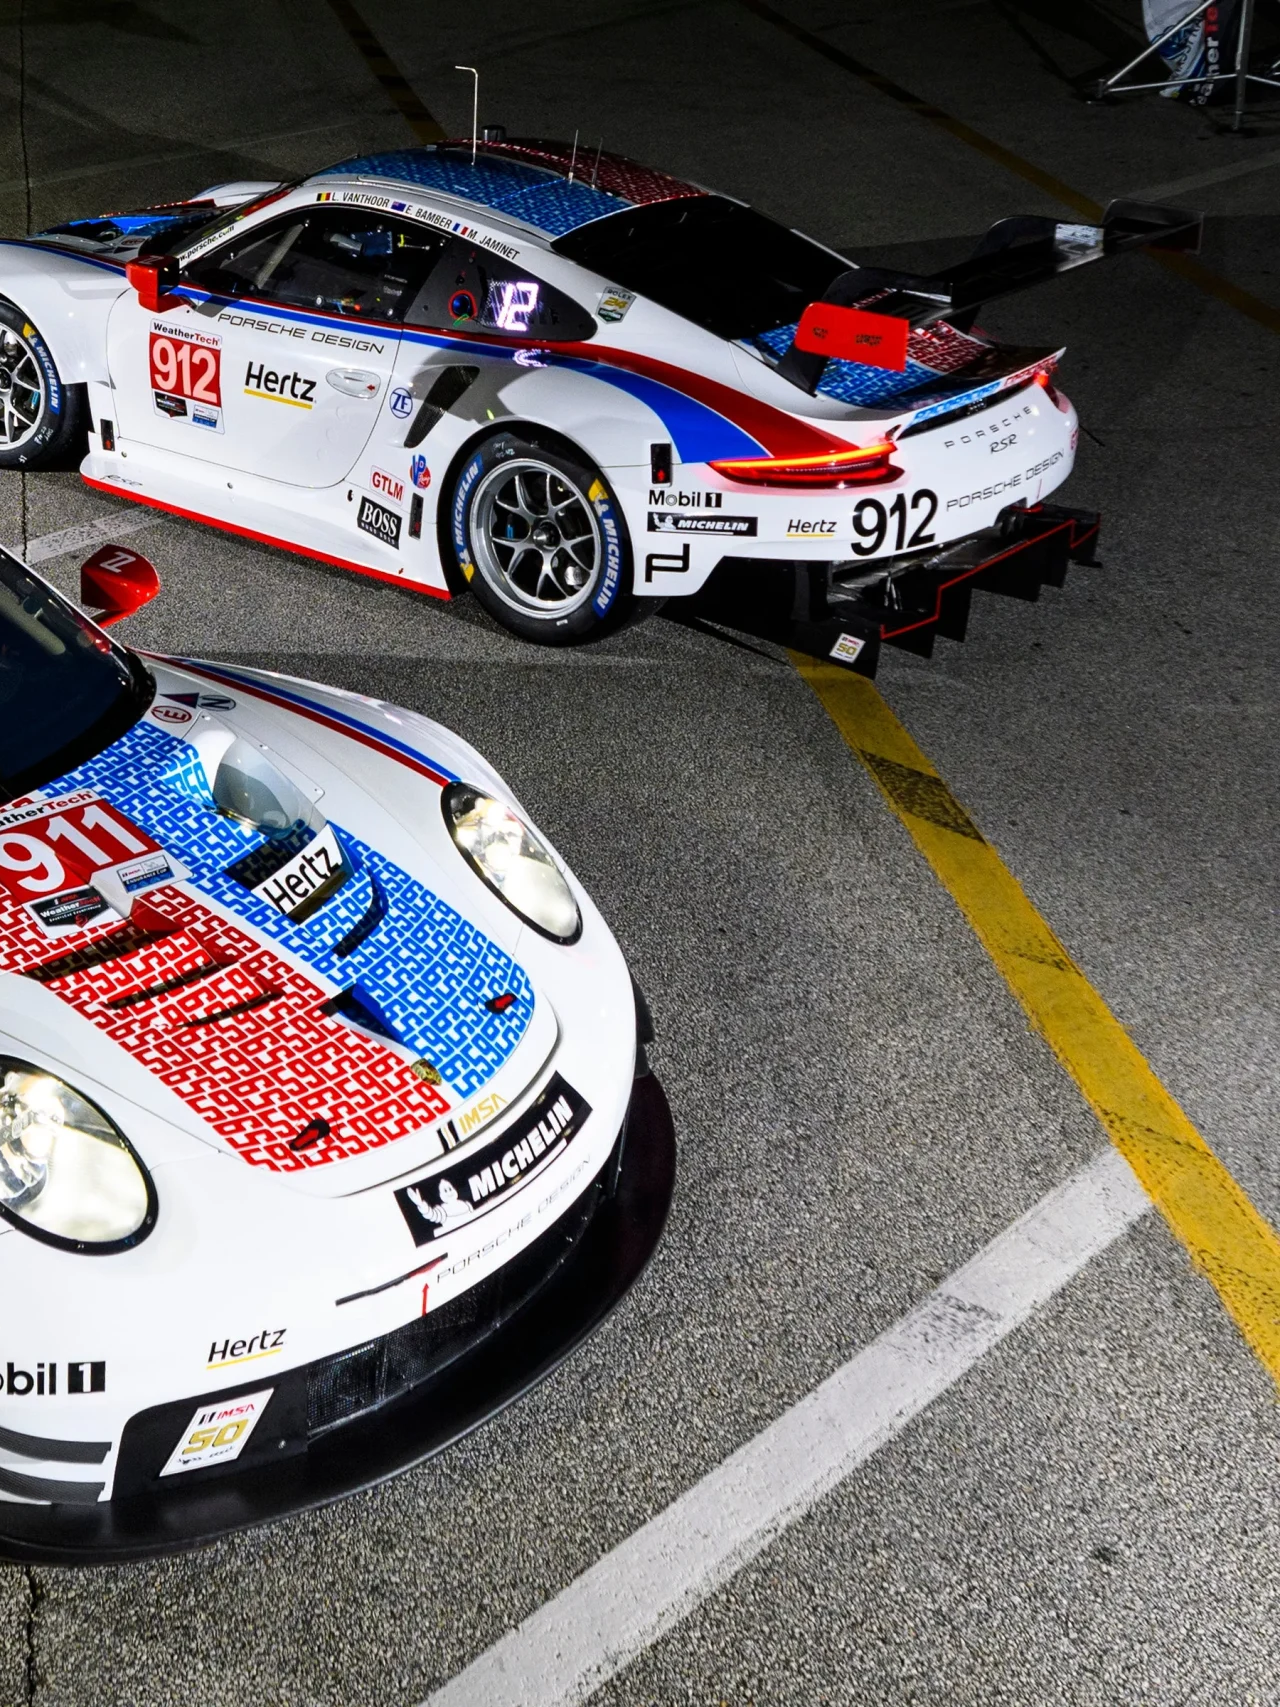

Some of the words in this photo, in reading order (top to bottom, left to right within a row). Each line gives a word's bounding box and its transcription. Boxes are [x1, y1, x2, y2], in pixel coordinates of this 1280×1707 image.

[342, 192, 391, 208] VANTHOOR
[415, 206, 453, 229] BAMBER
[479, 234, 521, 261] JAMINET
[153, 321, 219, 346] WeatherTech
[217, 314, 307, 338] PORSCHE
[311, 332, 385, 354] DESIGN
[35, 344, 58, 408] MICHELIN
[151, 337, 218, 404] 912
[244, 361, 317, 402] Hertz
[943, 406, 1032, 449] PORSCHE
[989, 433, 1018, 455] RSR
[372, 472, 404, 502] GTLM
[648, 490, 701, 508] Mobil
[946, 473, 1022, 512] PORSCHE
[1025, 448, 1064, 481] DESIGN
[361, 500, 398, 538] BOSS
[453, 462, 479, 546] MICHELIN
[677, 519, 749, 532] MICHELIN
[850, 488, 938, 557] 912
[787, 519, 837, 534] Hertz
[596, 518, 619, 610] MICHELIN
[262, 846, 342, 915] Hertz
[459, 1092, 508, 1135] IMSA
[468, 1095, 574, 1202] MICHELIN
[436, 1213, 532, 1284] PORSCHE
[207, 1328, 287, 1363] Hertz
[181, 1418, 250, 1456] 50
